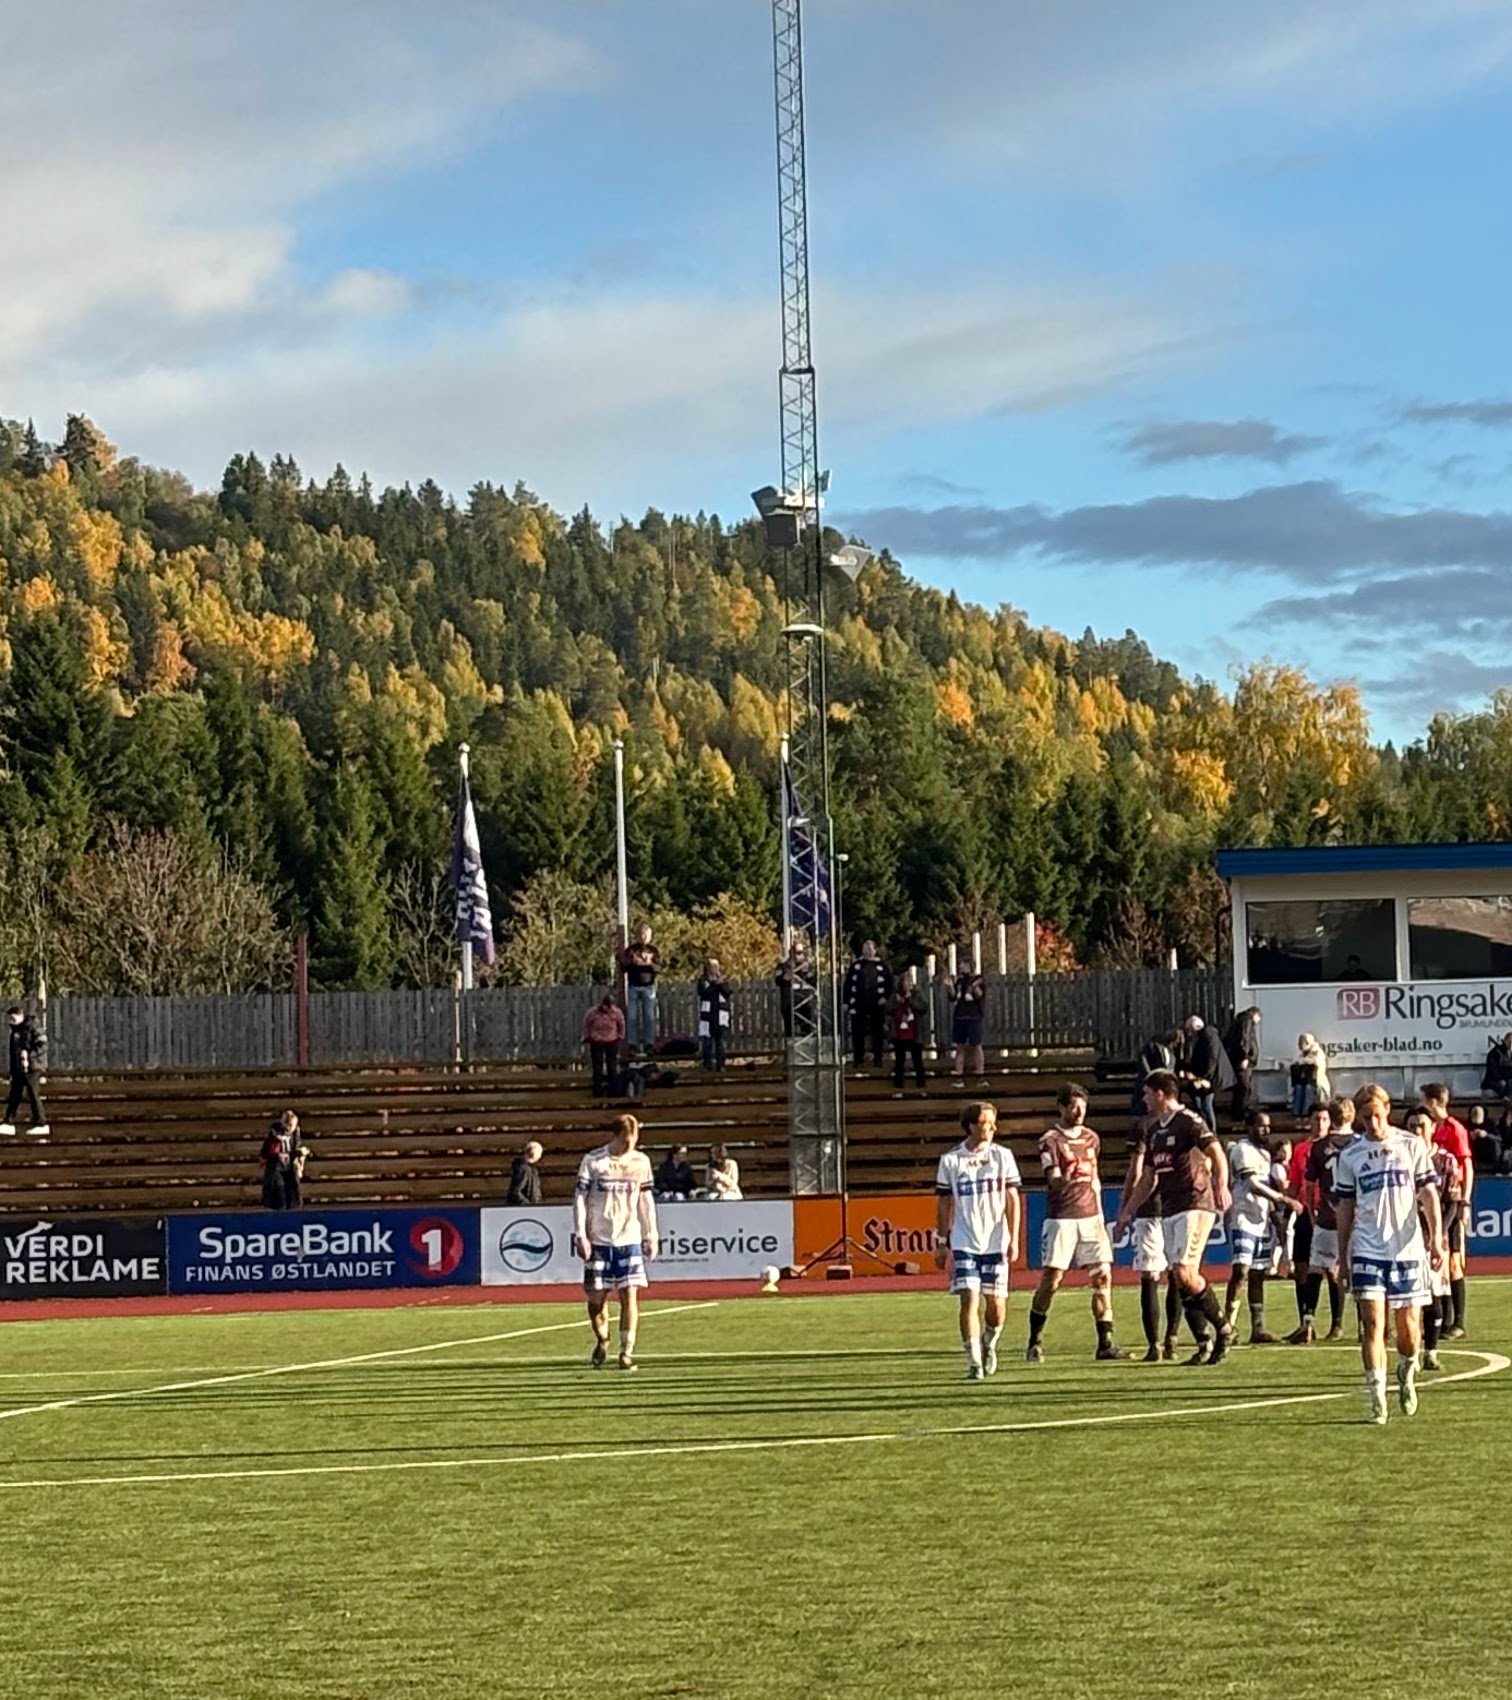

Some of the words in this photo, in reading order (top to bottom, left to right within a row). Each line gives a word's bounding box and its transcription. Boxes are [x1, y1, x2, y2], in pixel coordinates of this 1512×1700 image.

[1342, 990, 1376, 1017] RB
[4, 1234, 104, 1258] VERDI
[199, 1221, 394, 1263] SpareBank
[421, 1228, 442, 1271] 1
[6, 1257, 160, 1284] REKLAME
[186, 1264, 264, 1282] FINANS
[271, 1260, 396, 1280] ØSTLANDET
